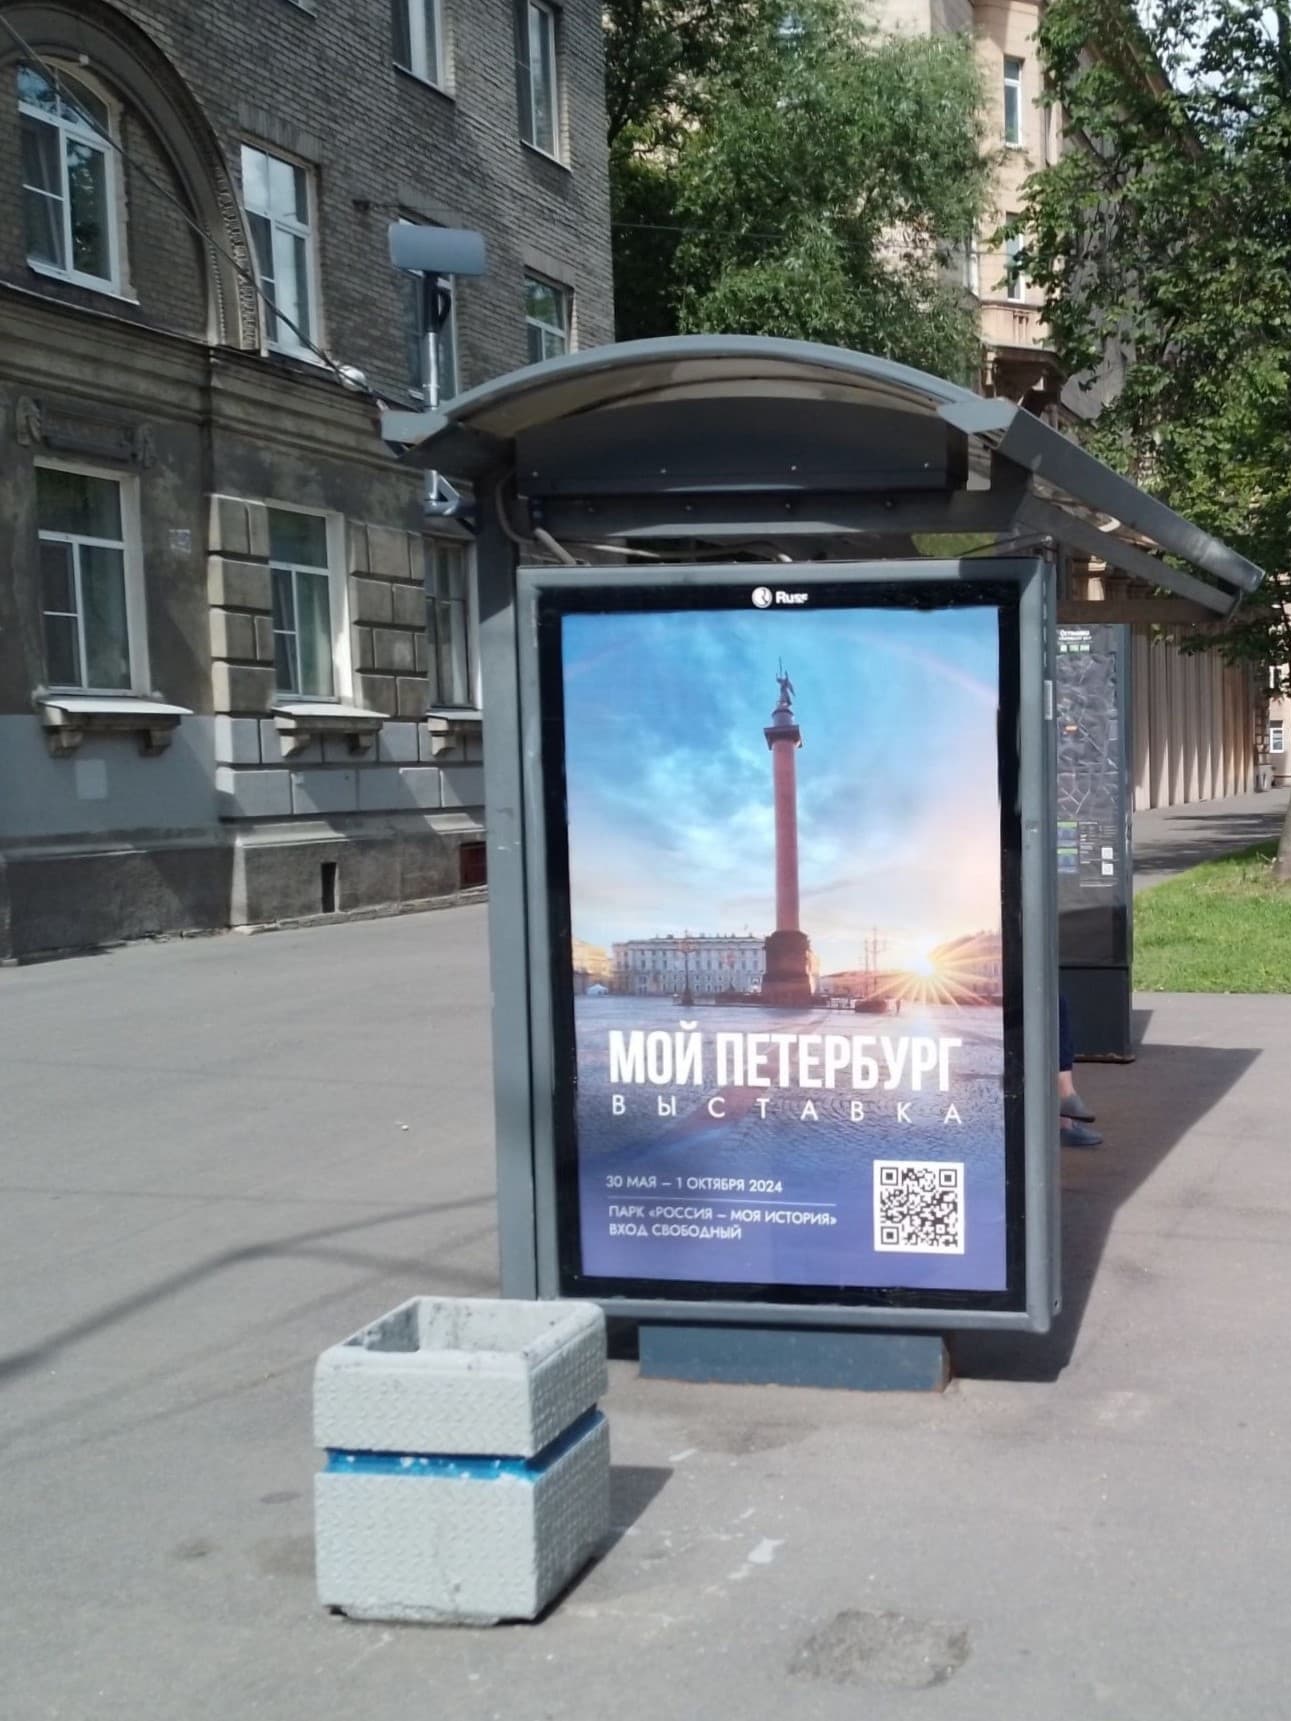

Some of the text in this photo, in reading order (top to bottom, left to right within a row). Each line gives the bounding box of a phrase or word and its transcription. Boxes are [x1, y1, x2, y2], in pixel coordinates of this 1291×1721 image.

[608, 1020, 963, 1092] МОЙ ПЕТЕРБУРГ
[612, 1094, 963, 1125] ВЫСТАВКА
[605, 1175, 623, 1188] 30
[626, 1176, 657, 1188] МАЯ
[676, 1177, 682, 1189] 1
[686, 1177, 745, 1191] ОКТЯБРЯ
[749, 1179, 783, 1193] 2024
[608, 1205, 645, 1218] ПАРК
[649, 1206, 713, 1220] «РОССИЯ
[730, 1209, 761, 1222] МОЯ
[765, 1211, 838, 1225] ИСТОРИЯ»
[609, 1223, 742, 1240] ВХОД СВОБОДНЫЙ
